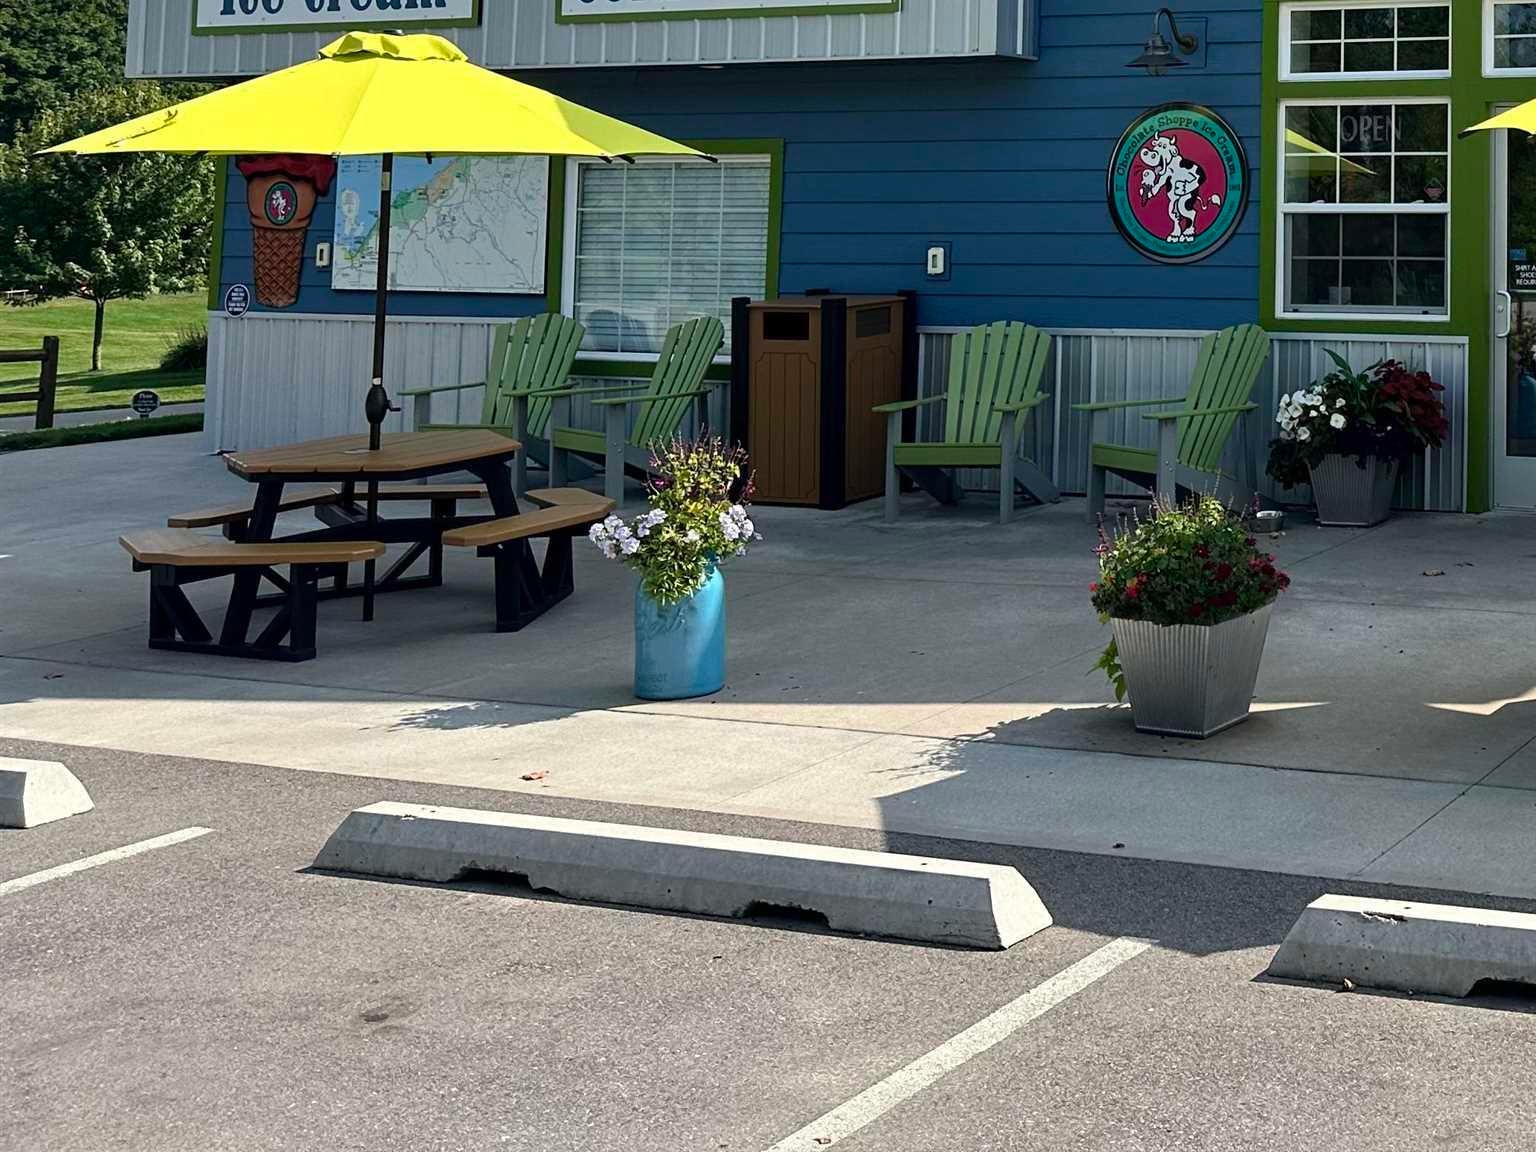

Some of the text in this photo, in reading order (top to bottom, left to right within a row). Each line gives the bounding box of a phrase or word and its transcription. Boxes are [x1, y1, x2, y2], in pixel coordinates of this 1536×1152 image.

[1116, 116, 1236, 176] Chocolate Shoppe Ice Cream
[1340, 114, 1402, 143] OPEN
